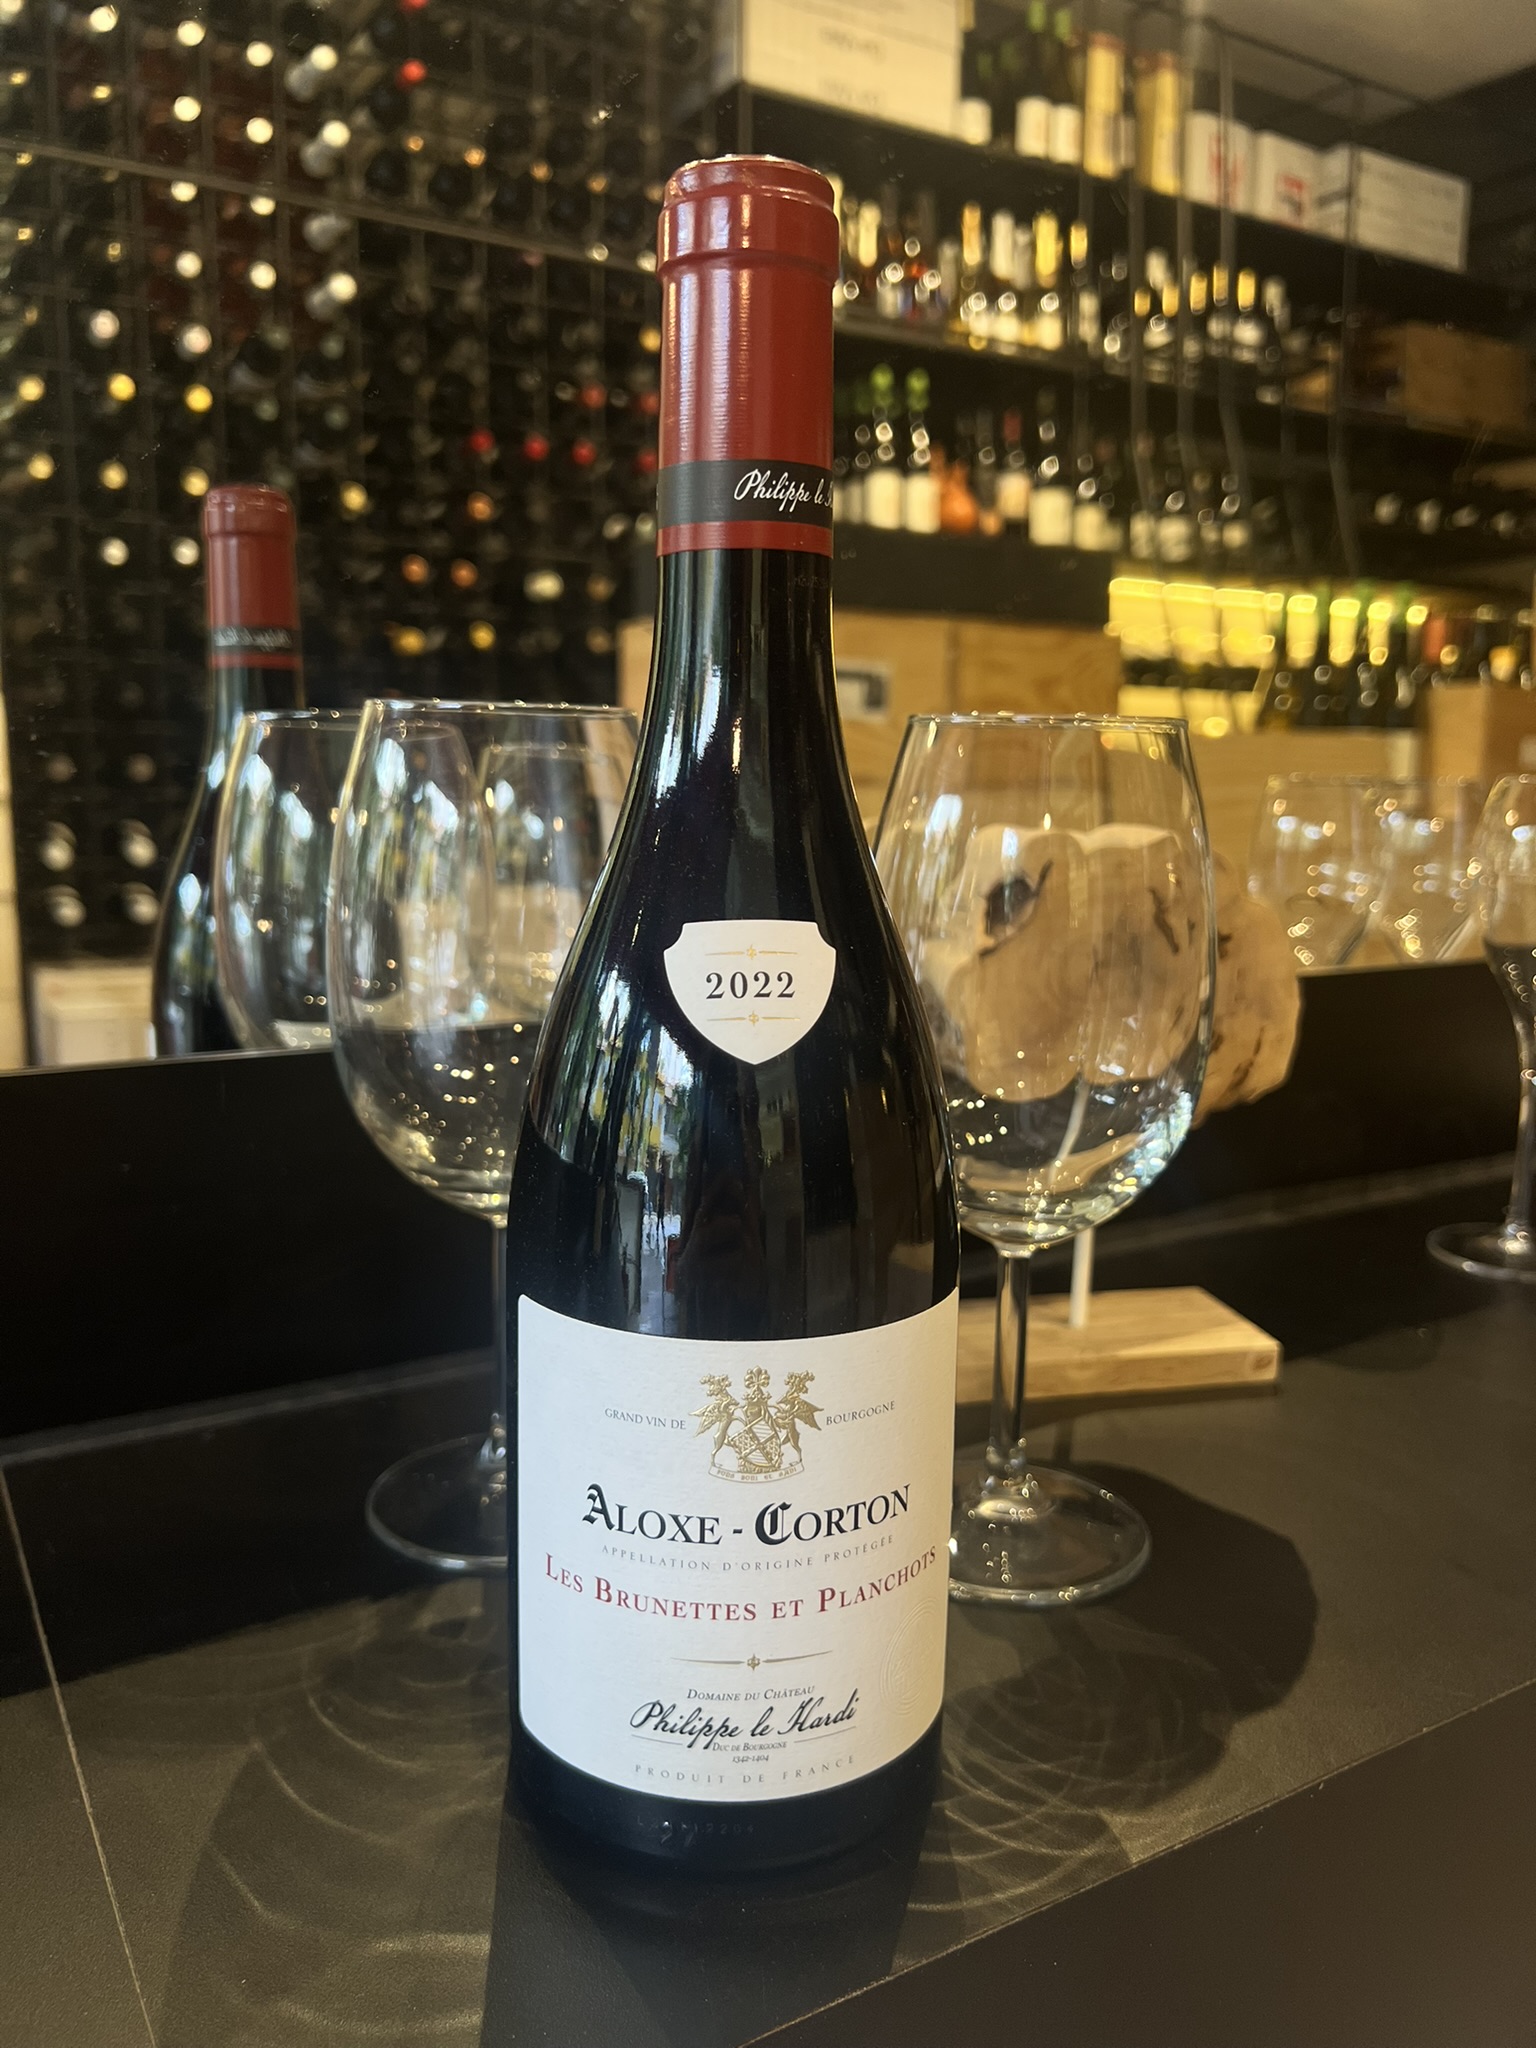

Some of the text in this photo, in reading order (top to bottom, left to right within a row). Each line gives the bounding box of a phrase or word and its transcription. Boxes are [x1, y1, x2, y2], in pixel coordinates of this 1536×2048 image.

[734, 469, 812, 512] Philippe
[706, 971, 796, 1000] 2022
[605, 1408, 687, 1430] GRAND VIN DE
[826, 1400, 895, 1426] BOURGOGNE
[582, 1483, 723, 1545] ALOXE
[755, 1483, 911, 1546] CORTON
[602, 1534, 893, 1571] APPELLATION D'ORIGINE PROTÉGÉE
[546, 1545, 936, 1622] LES BRUNETTES ET PLANCHOTS
[687, 1685, 816, 1701] DOMAINE DU CHÂTEAU
[629, 1687, 860, 1750] Philippe le Hardi
[712, 1742, 730, 1752] DUC
[742, 1741, 788, 1752] BOURGOGNE
[732, 1755, 770, 1764] 1342-1404
[635, 1754, 854, 1784] PRODUIT DE FRANCE
